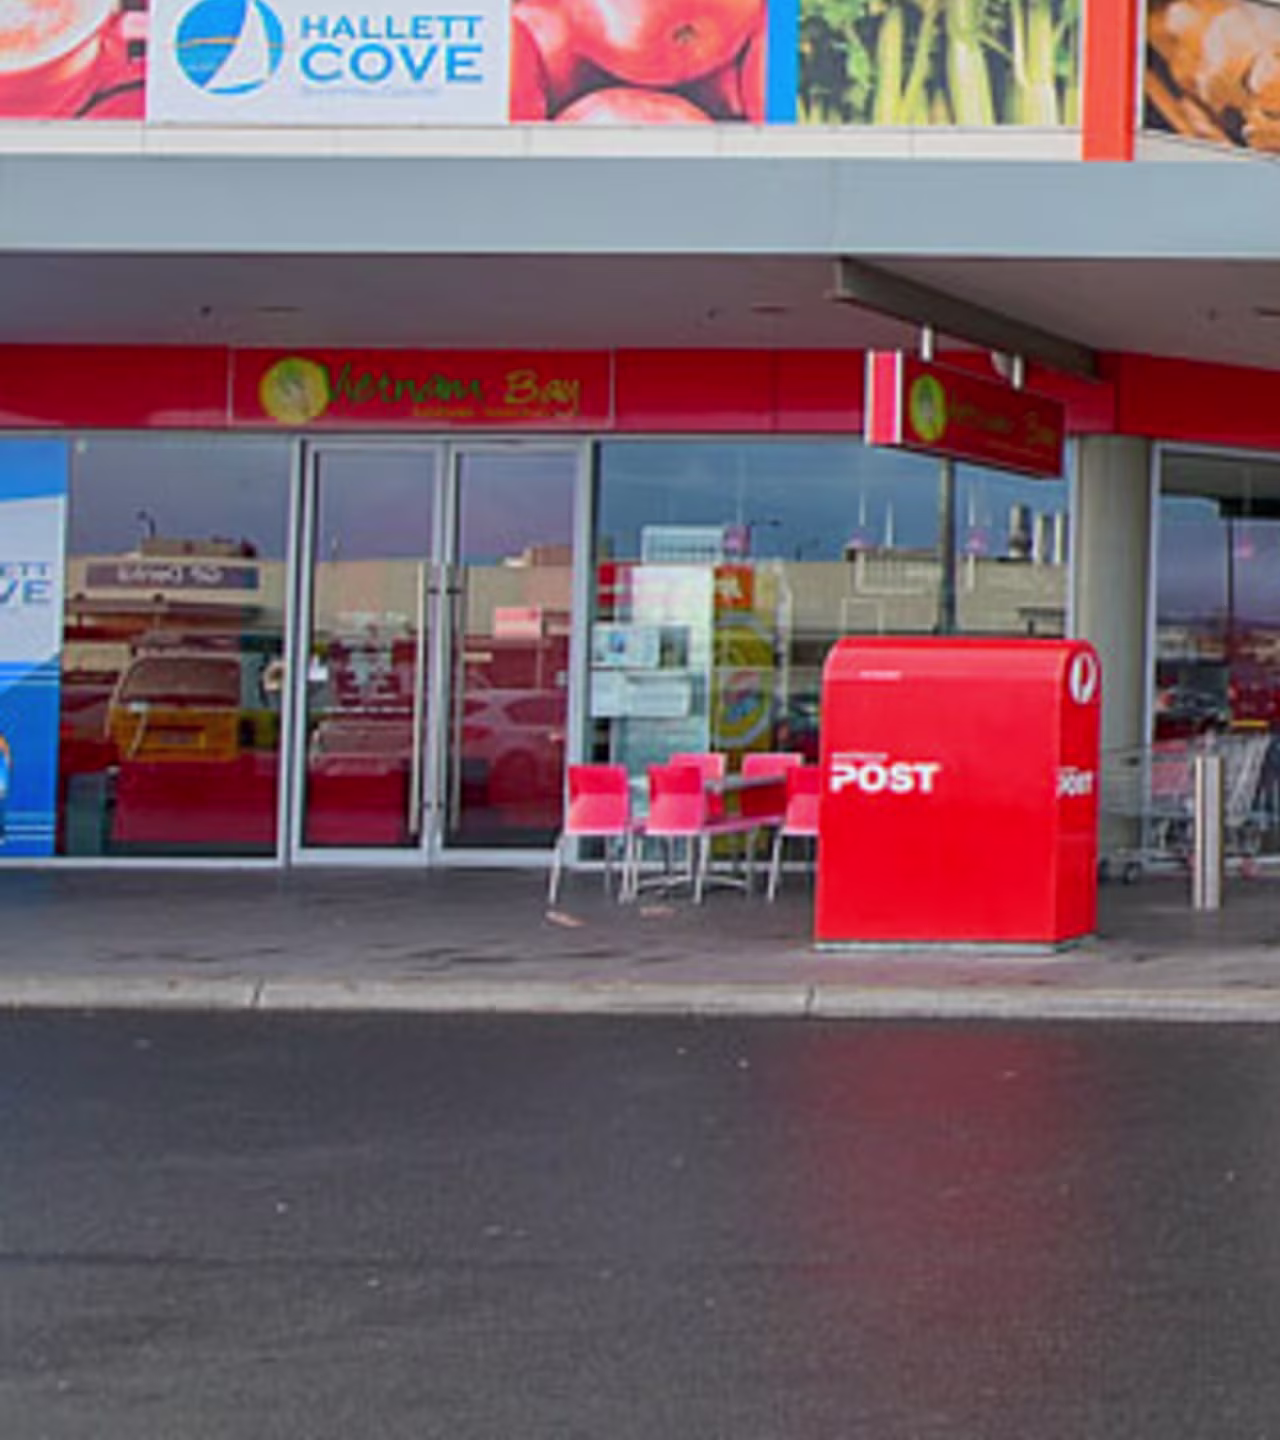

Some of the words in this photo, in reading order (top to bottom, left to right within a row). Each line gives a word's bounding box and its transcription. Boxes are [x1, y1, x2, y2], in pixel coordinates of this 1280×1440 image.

[301, 15, 483, 39] HALLETT
[299, 42, 483, 82] COVE
[503, 369, 580, 417] Bay
[0, 580, 52, 603] VE
[830, 762, 942, 794] POST
